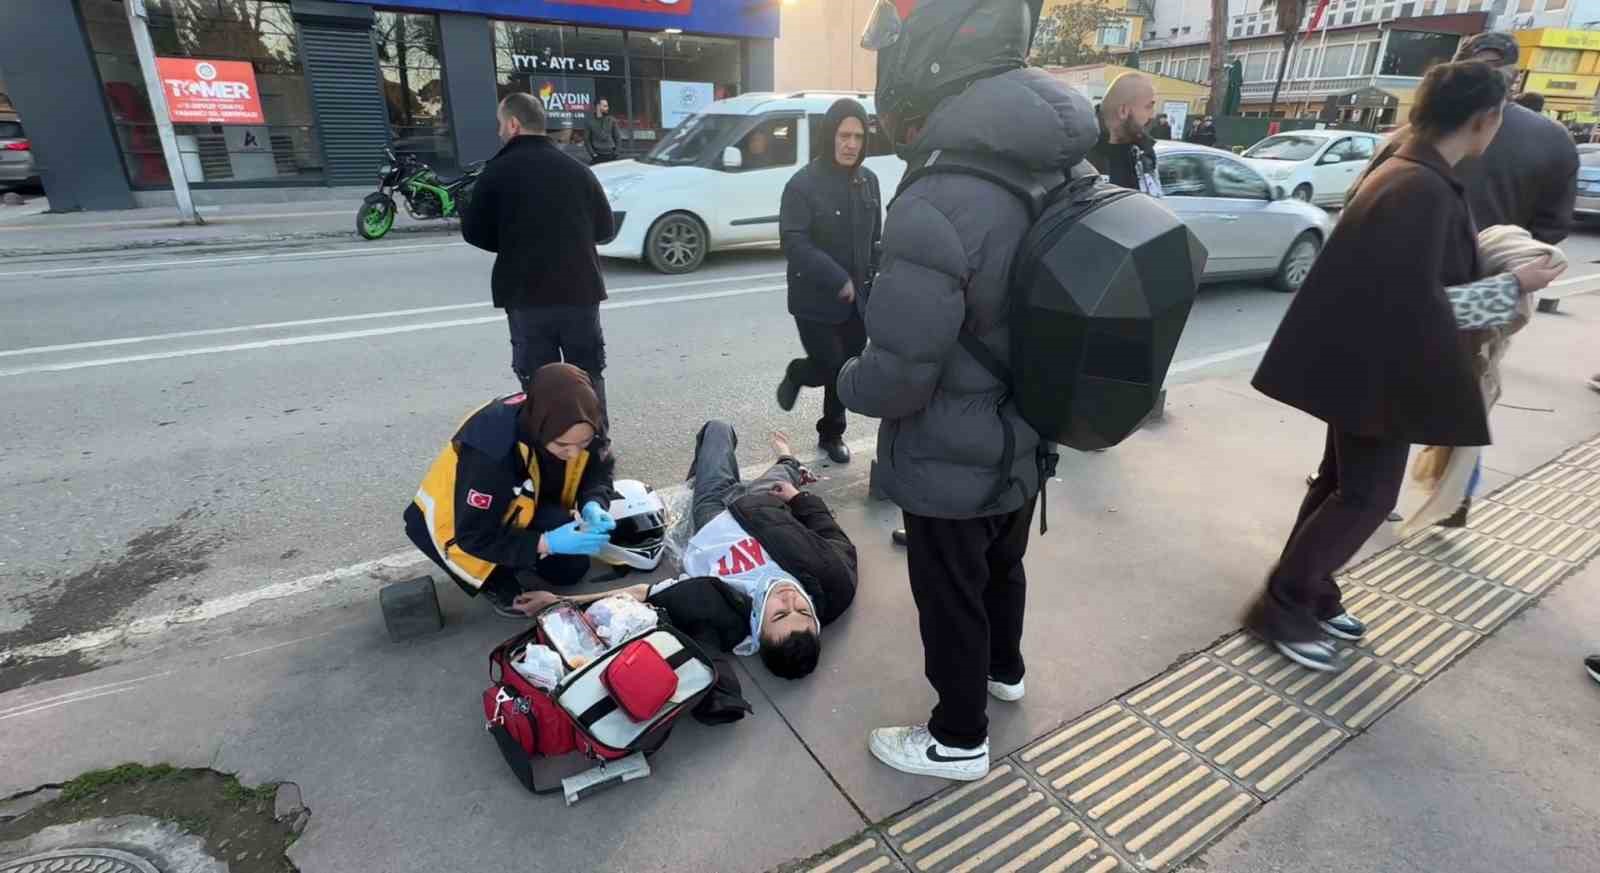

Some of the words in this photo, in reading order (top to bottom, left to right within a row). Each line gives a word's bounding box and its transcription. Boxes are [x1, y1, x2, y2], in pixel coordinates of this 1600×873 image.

[512, 54, 539, 69] TYT
[549, 56, 575, 70] AYT
[585, 59, 610, 72] LGS
